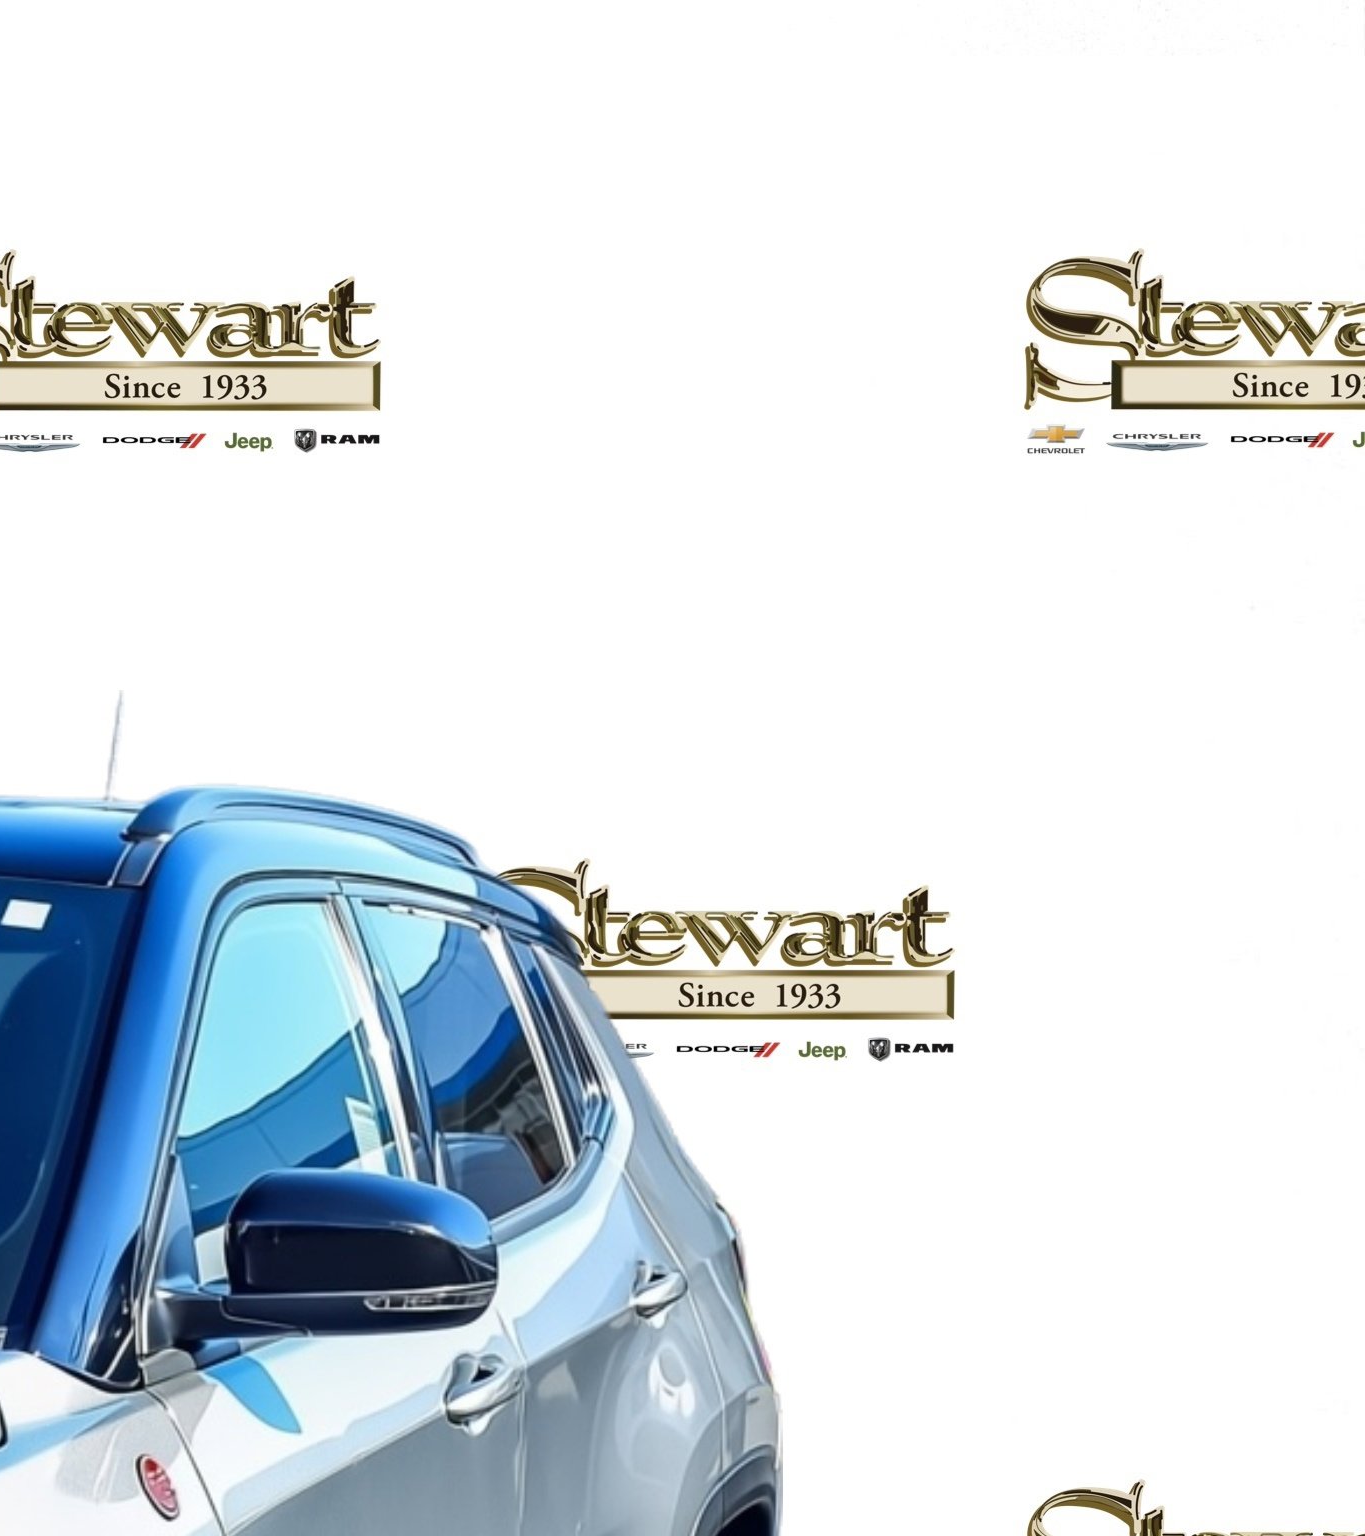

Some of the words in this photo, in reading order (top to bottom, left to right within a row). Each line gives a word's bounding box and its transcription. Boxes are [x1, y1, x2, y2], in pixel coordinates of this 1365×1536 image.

[104, 373, 181, 399] Since
[201, 374, 268, 401] 1933
[1232, 372, 1309, 398] Since
[1329, 373, 1365, 400] 19
[102, 436, 191, 444] DODGE
[224, 432, 274, 452] Jeep
[320, 434, 381, 444] RAM
[1230, 435, 1319, 443] DODGE
[678, 982, 755, 1008] Since
[775, 983, 842, 1010] 1933
[676, 1045, 765, 1053] DODGE
[798, 1041, 848, 1061] Jeep
[894, 1043, 955, 1053] RAM
